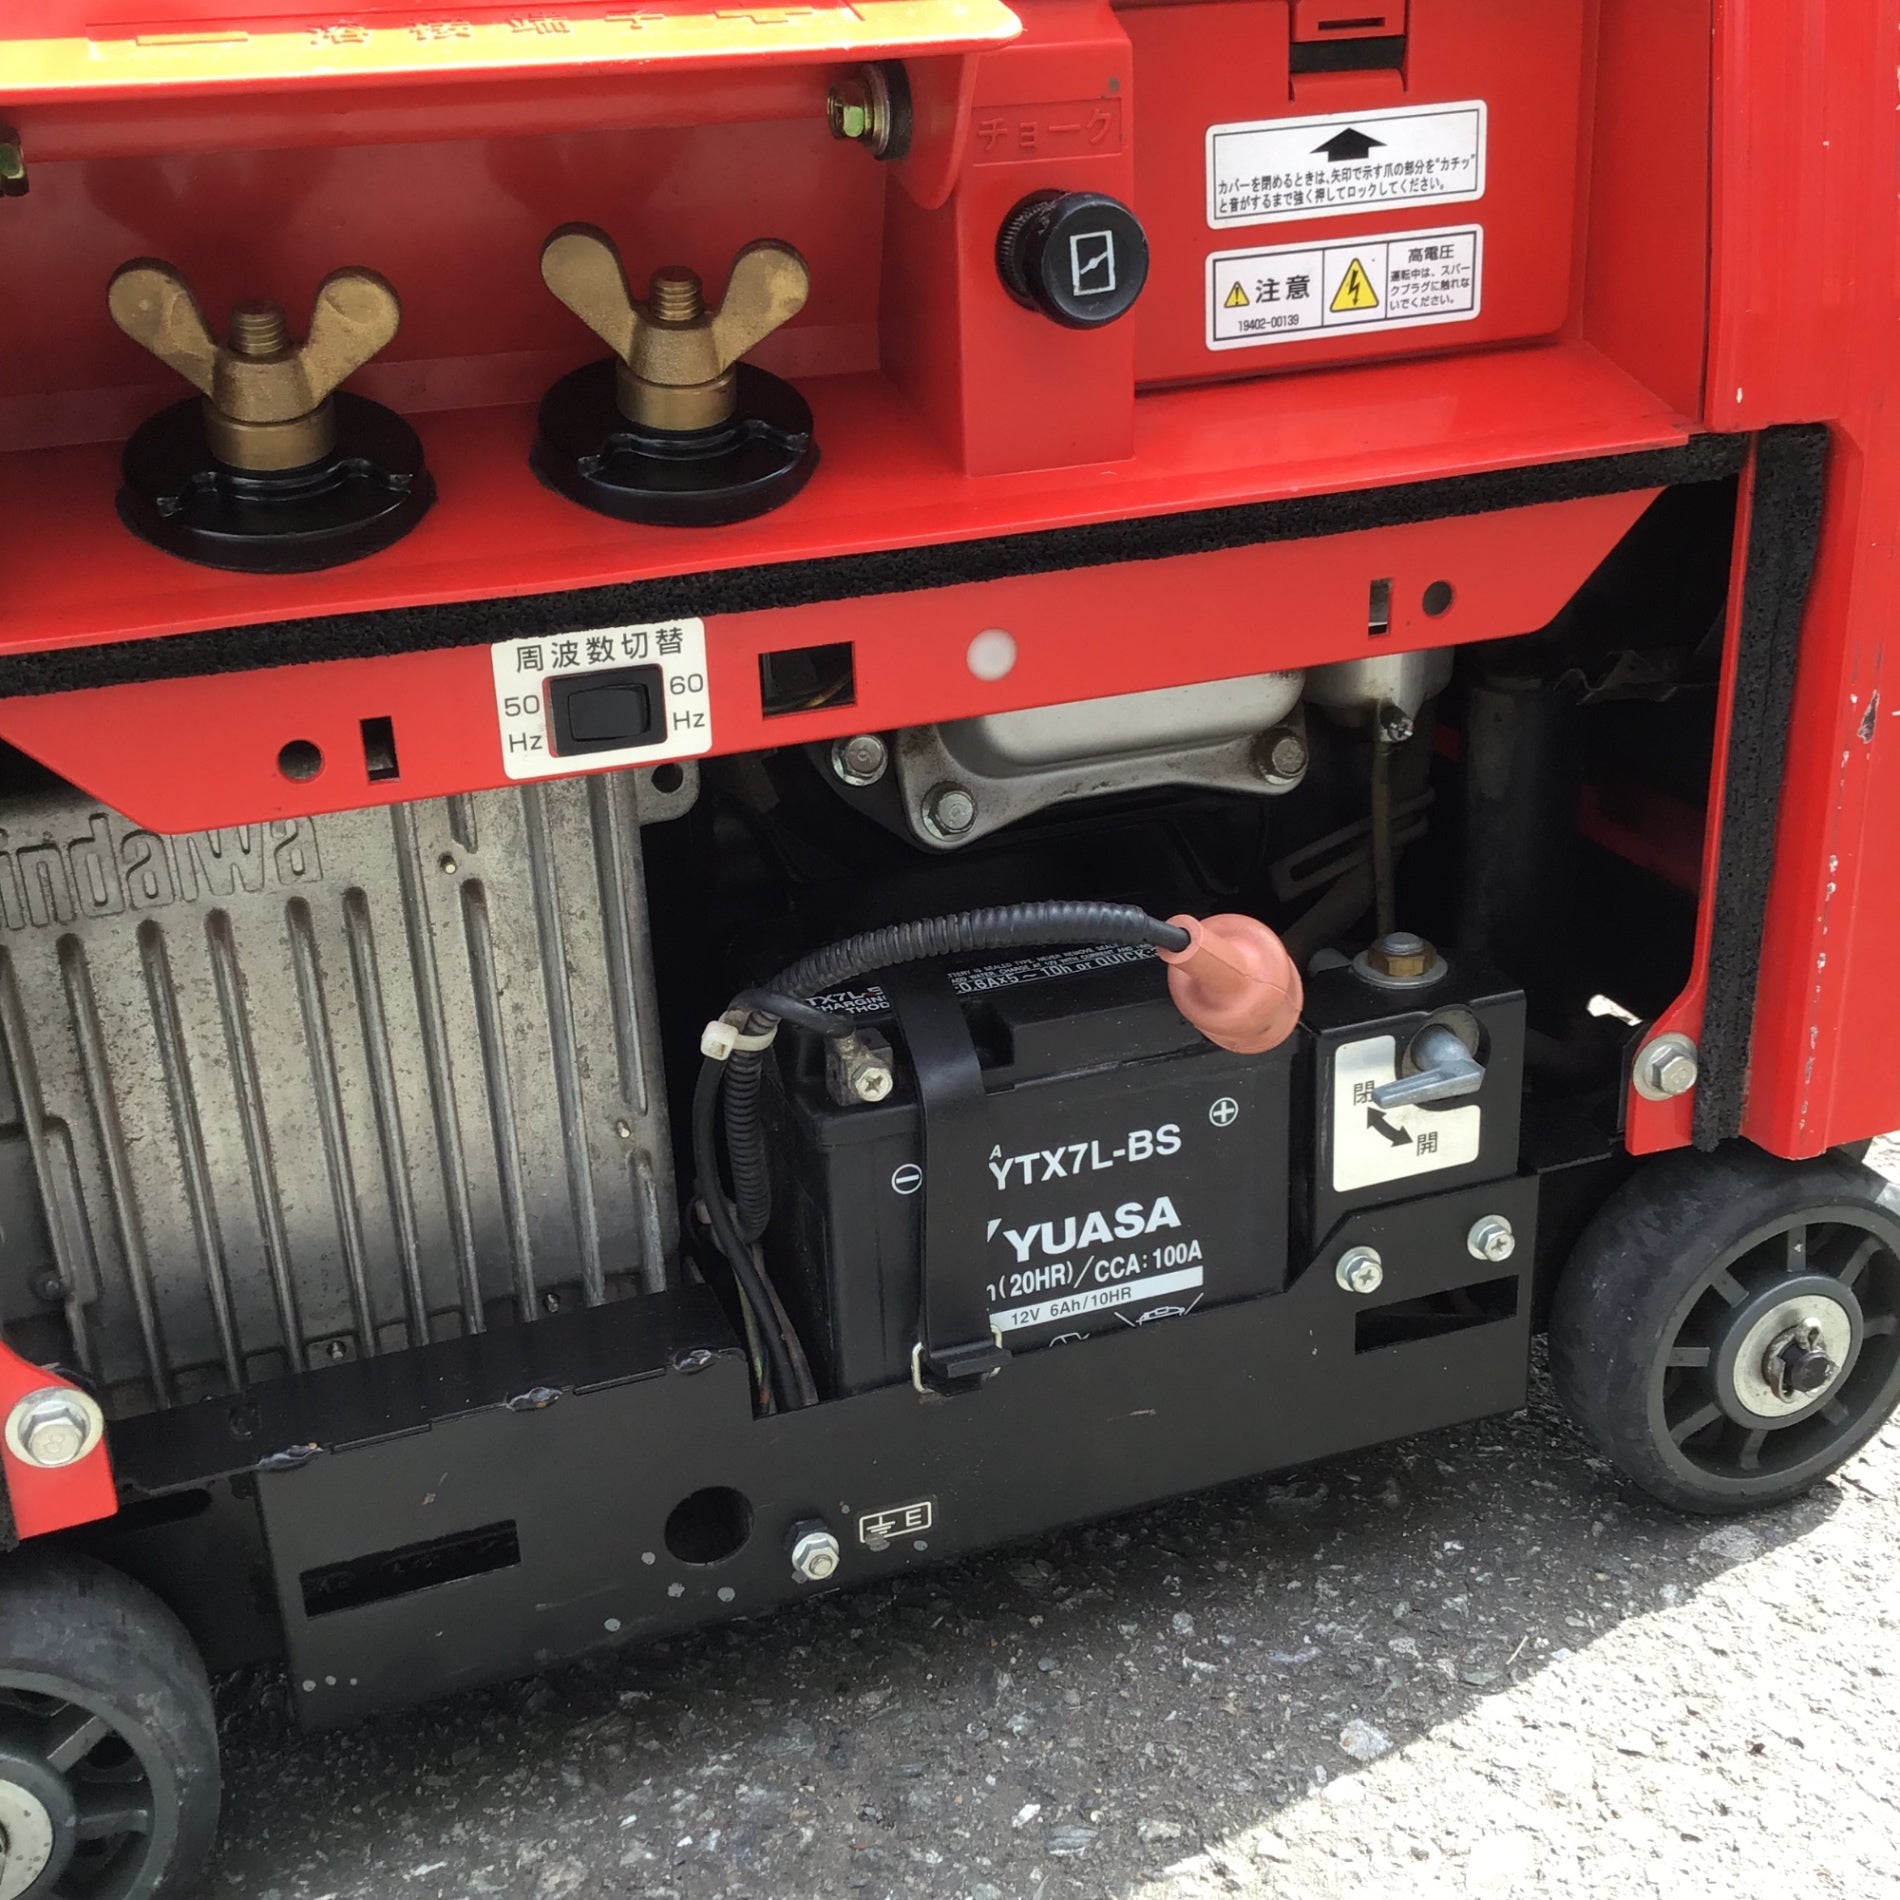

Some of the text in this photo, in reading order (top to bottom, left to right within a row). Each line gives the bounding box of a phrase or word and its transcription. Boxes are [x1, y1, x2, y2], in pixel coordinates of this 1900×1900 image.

[978, 109, 1112, 150] チョーク
[1408, 244, 1455, 263] 高電圧
[1255, 275, 1311, 303] 注意
[1238, 314, 1299, 332] 19402-00139
[516, 627, 684, 673] 周波数切替
[669, 673, 704, 695] 60
[504, 694, 540, 717] 50
[673, 711, 705, 731] Hz
[508, 732, 543, 753] Hz
[1353, 1080, 1375, 1106] 閉
[988, 1124, 1182, 1190] YTX7L-BS
[1416, 1131, 1438, 1157] 開
[1003, 1196, 1182, 1263] YUASA
[1011, 1286, 1132, 1326] 12V 6Ah/10HR
[905, 1508, 922, 1527] E
